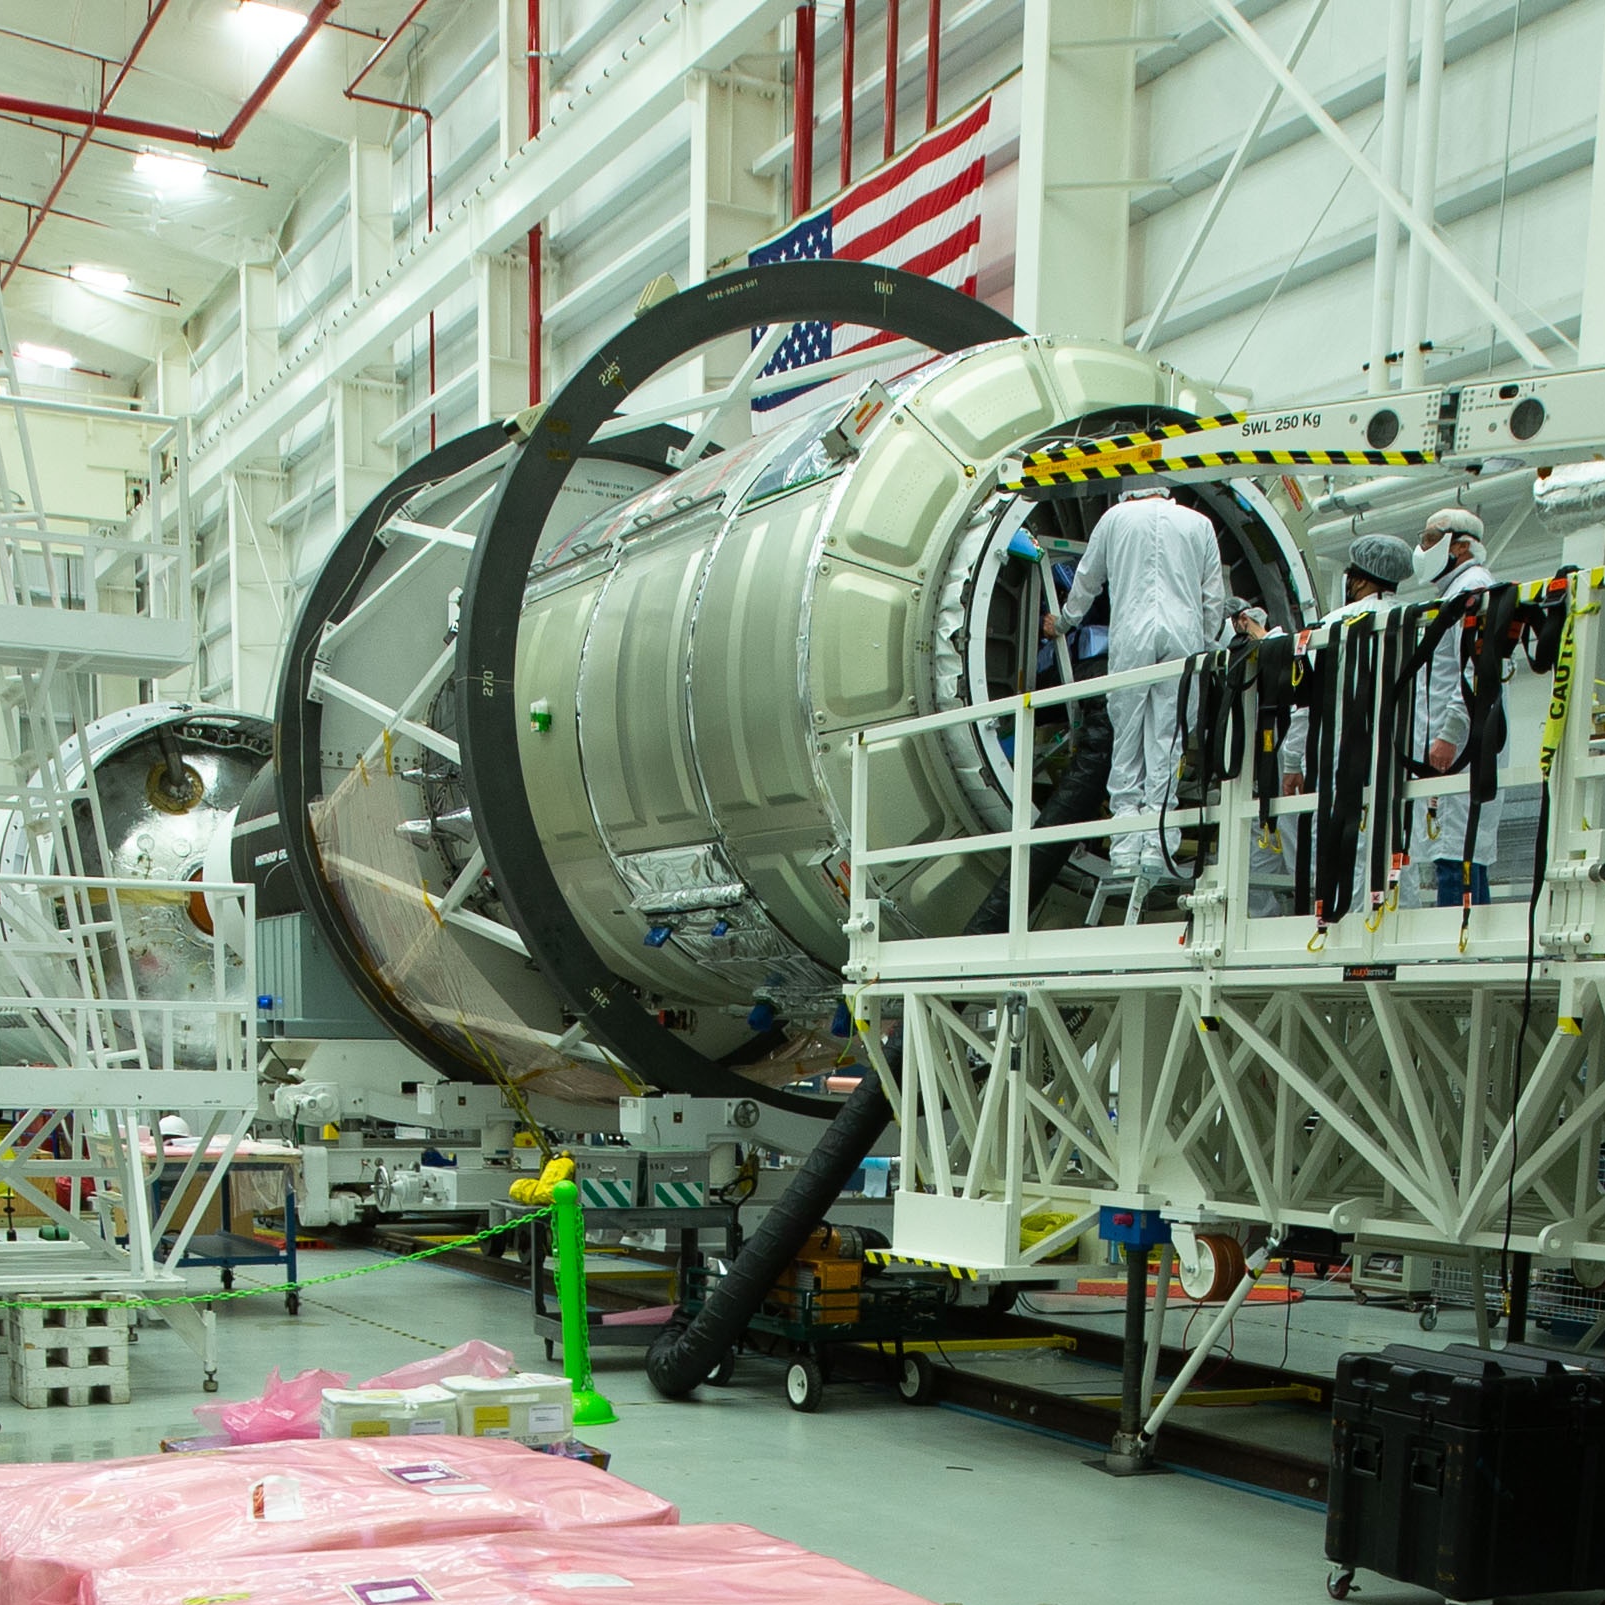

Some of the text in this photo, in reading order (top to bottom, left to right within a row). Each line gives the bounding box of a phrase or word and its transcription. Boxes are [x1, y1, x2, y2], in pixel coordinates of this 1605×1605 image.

[1241, 412, 1321, 438] SWL 250 Kg
